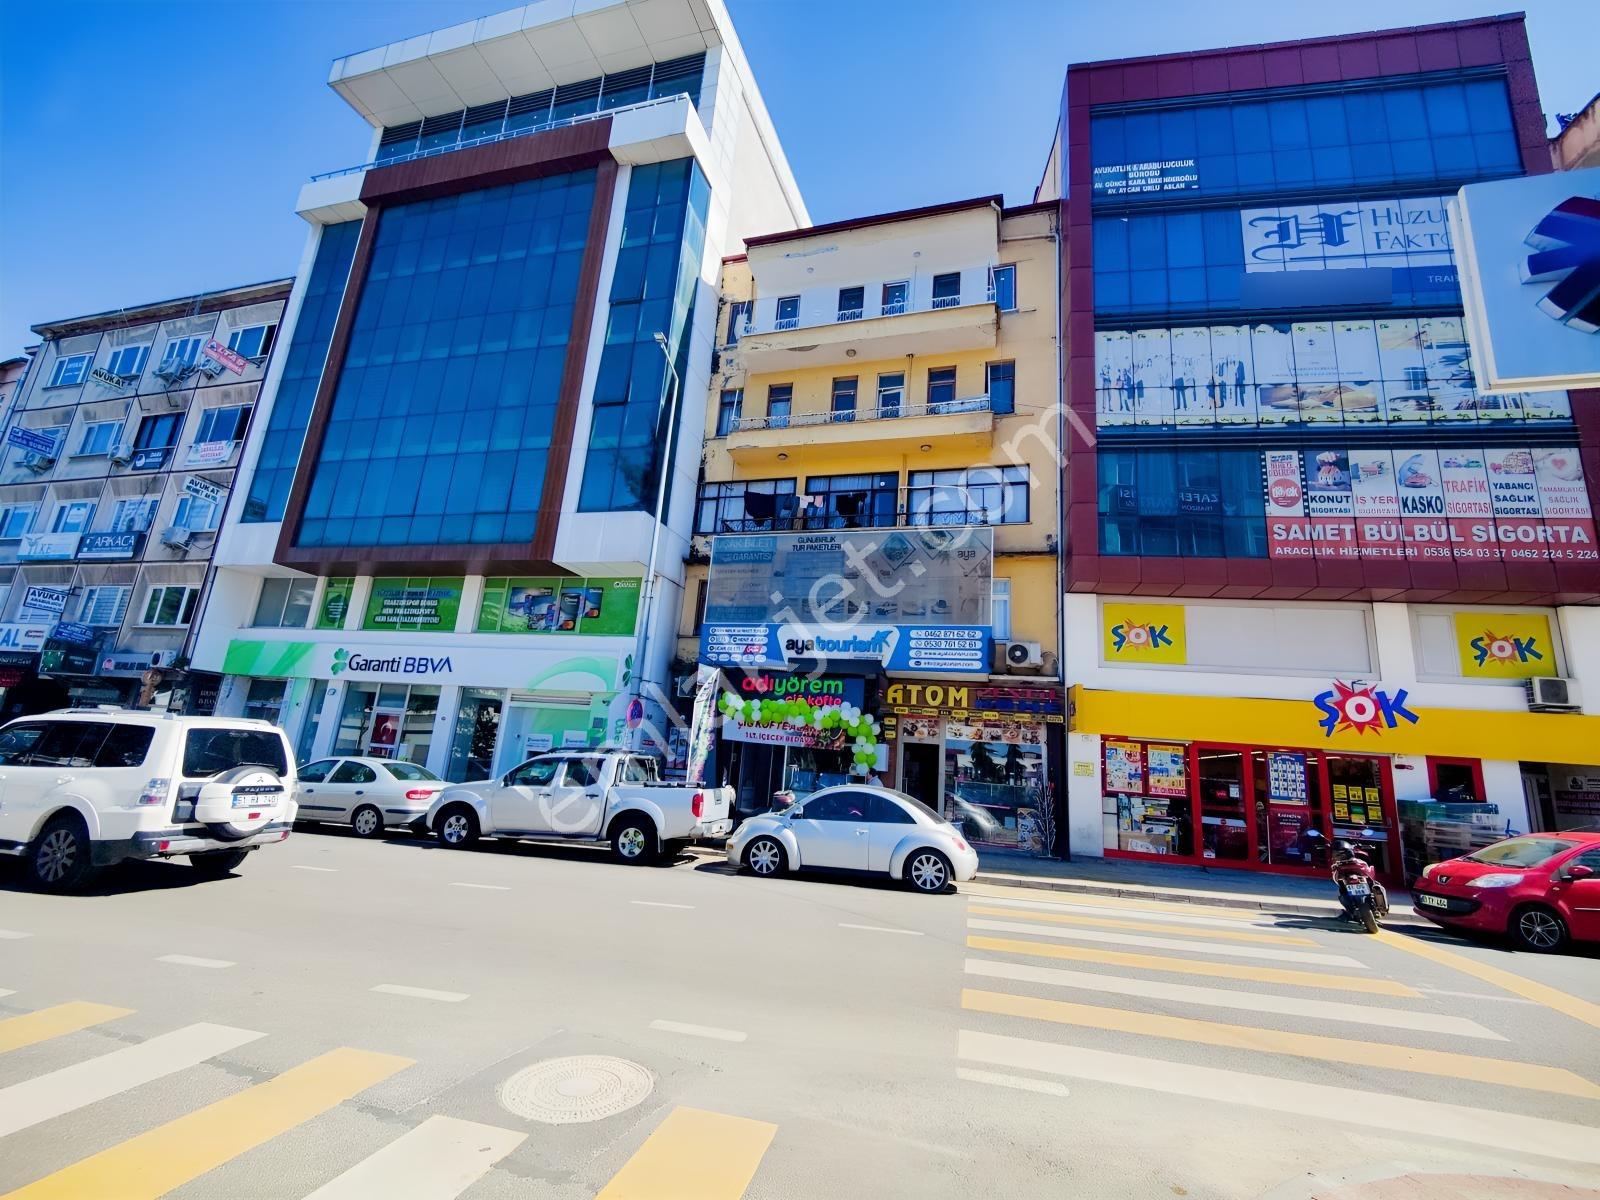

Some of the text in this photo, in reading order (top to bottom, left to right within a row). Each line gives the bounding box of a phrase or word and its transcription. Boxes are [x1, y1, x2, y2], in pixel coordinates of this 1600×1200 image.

[1371, 206, 1449, 228] HUZU
[92, 368, 126, 388] AVUKAT
[188, 477, 219, 497] AVUKAT
[1443, 478, 1487, 493] TRAFİK
[1310, 494, 1351, 504] KONUT
[1402, 494, 1444, 515] KASKO
[1447, 501, 1492, 515] SİGORTASI
[1494, 493, 1536, 503] SAĞLIK
[1494, 506, 1540, 515] SİGORTASI
[1272, 520, 1590, 544] SAMET BÜLBÜL SİGORTA
[957, 550, 976, 560] aya
[1275, 546, 1335, 556] ARACILIK
[1339, 547, 1418, 557] HİZMETLERİ
[1424, 547, 1450, 557] 0536
[1453, 548, 1474, 557] 654
[1476, 548, 1490, 557] 03
[1493, 549, 1507, 558] 37
[1511, 549, 1539, 558] 0462
[1542, 549, 1563, 558] 224
[1576, 550, 1599, 559] 224
[30, 588, 66, 603] AVUKAT
[785, 638, 815, 655] aya
[1111, 624, 1173, 653] ŞOK
[1470, 635, 1543, 667] ŞOK
[348, 653, 453, 674] Garanti BBVA
[742, 674, 844, 695] adıyörem
[807, 694, 842, 706] köfte
[886, 683, 969, 708] ATOM
[1313, 686, 1420, 738] ŞOK
